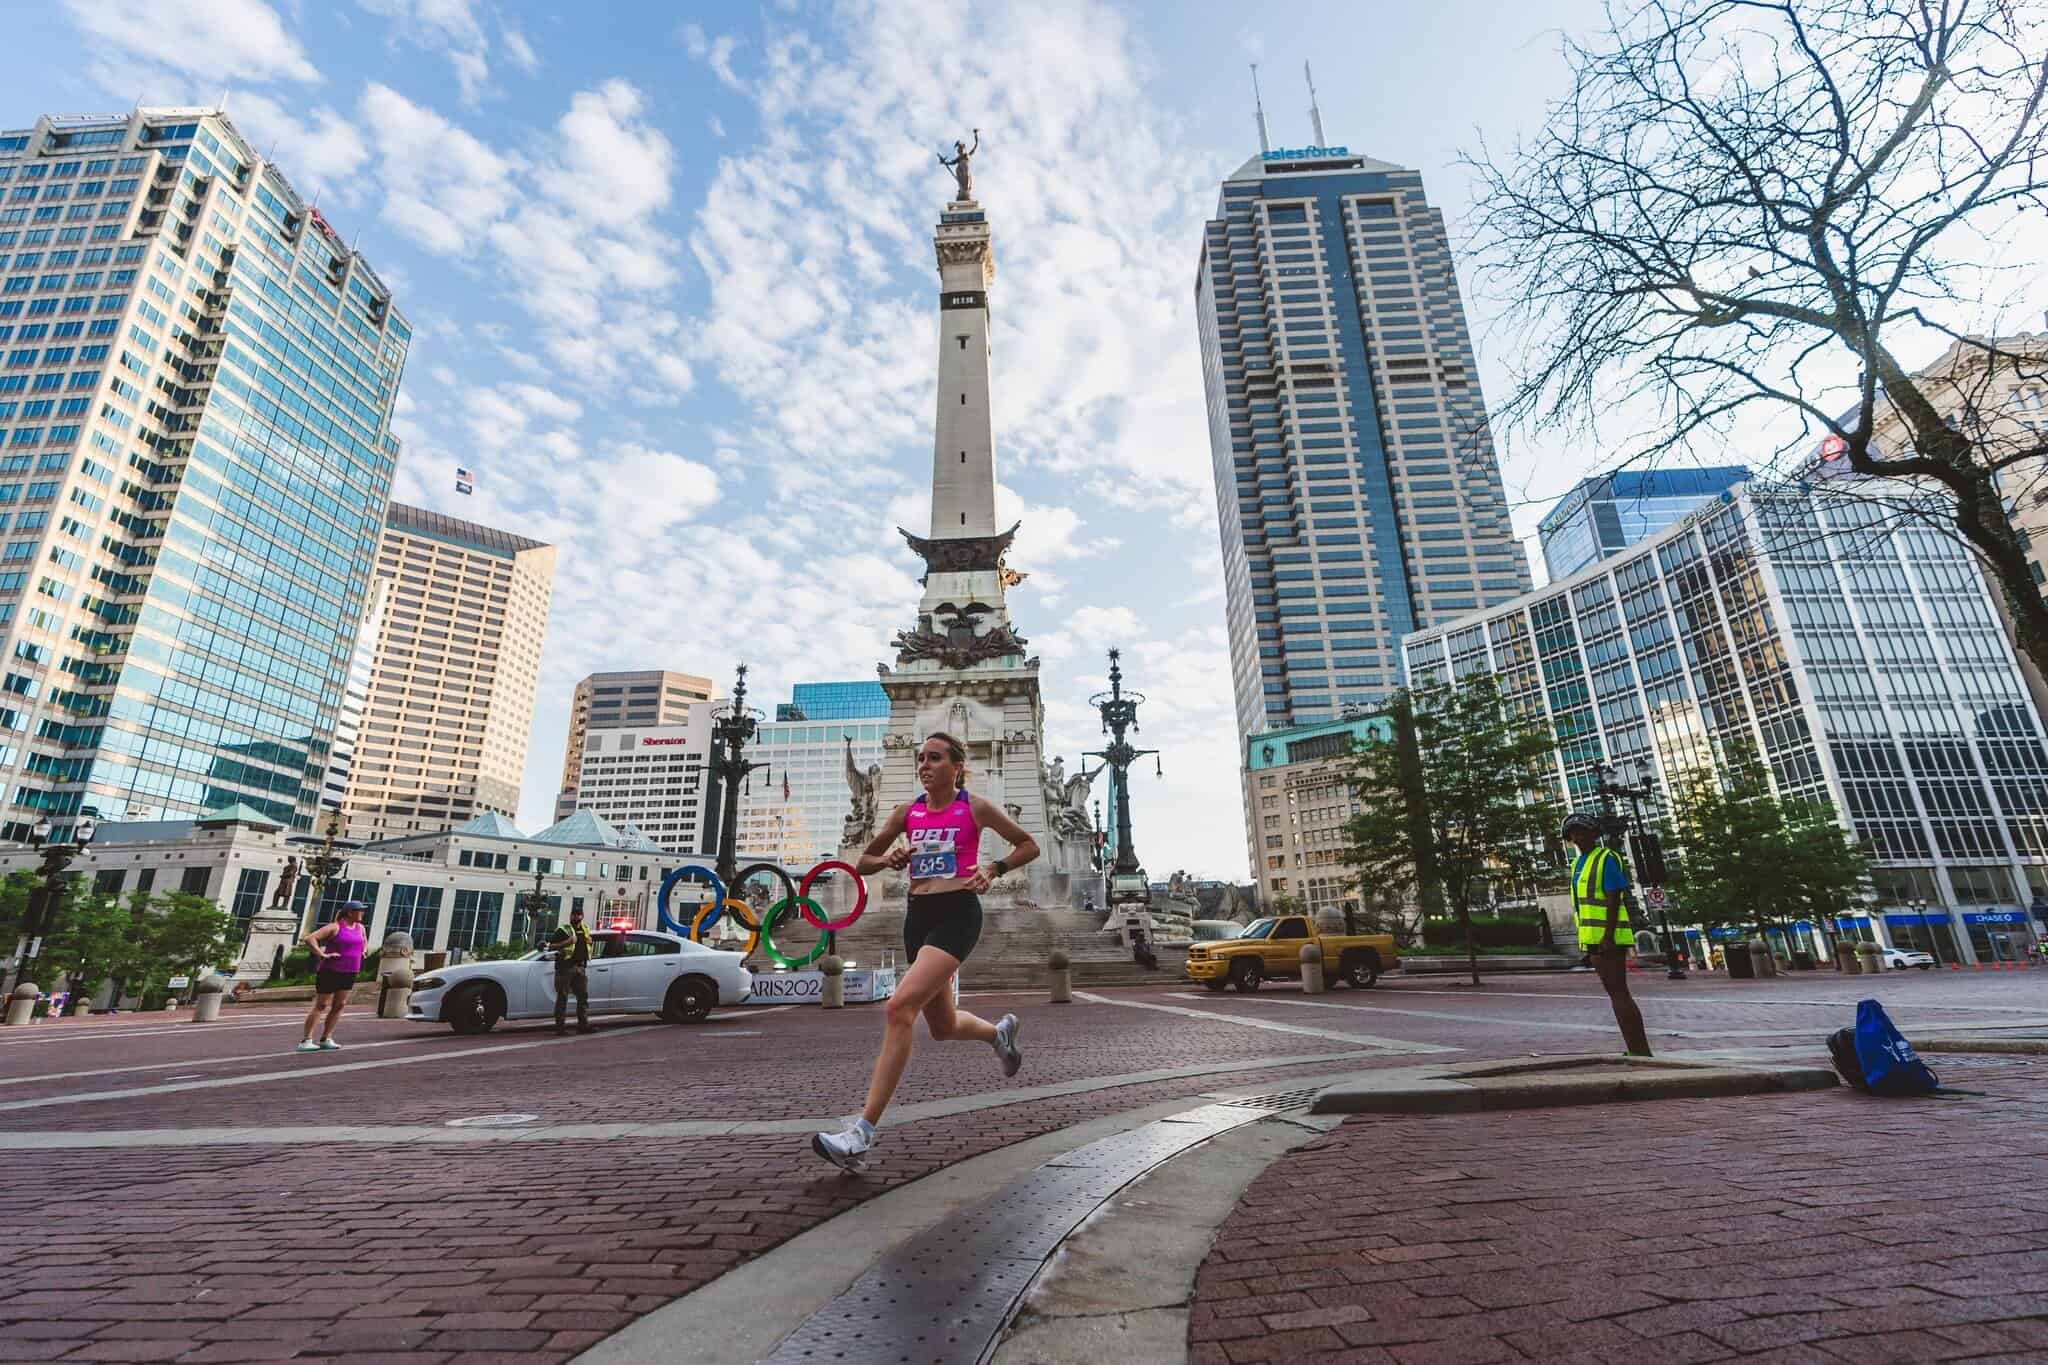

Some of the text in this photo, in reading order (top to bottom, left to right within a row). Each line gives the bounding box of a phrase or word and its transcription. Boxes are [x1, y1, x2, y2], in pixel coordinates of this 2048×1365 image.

[1262, 145, 1348, 160] salesforce
[1680, 496, 1722, 527] CHASE
[642, 737, 687, 746] Sheraton
[919, 857, 945, 873] 615
[750, 979, 823, 997] ARIS202
